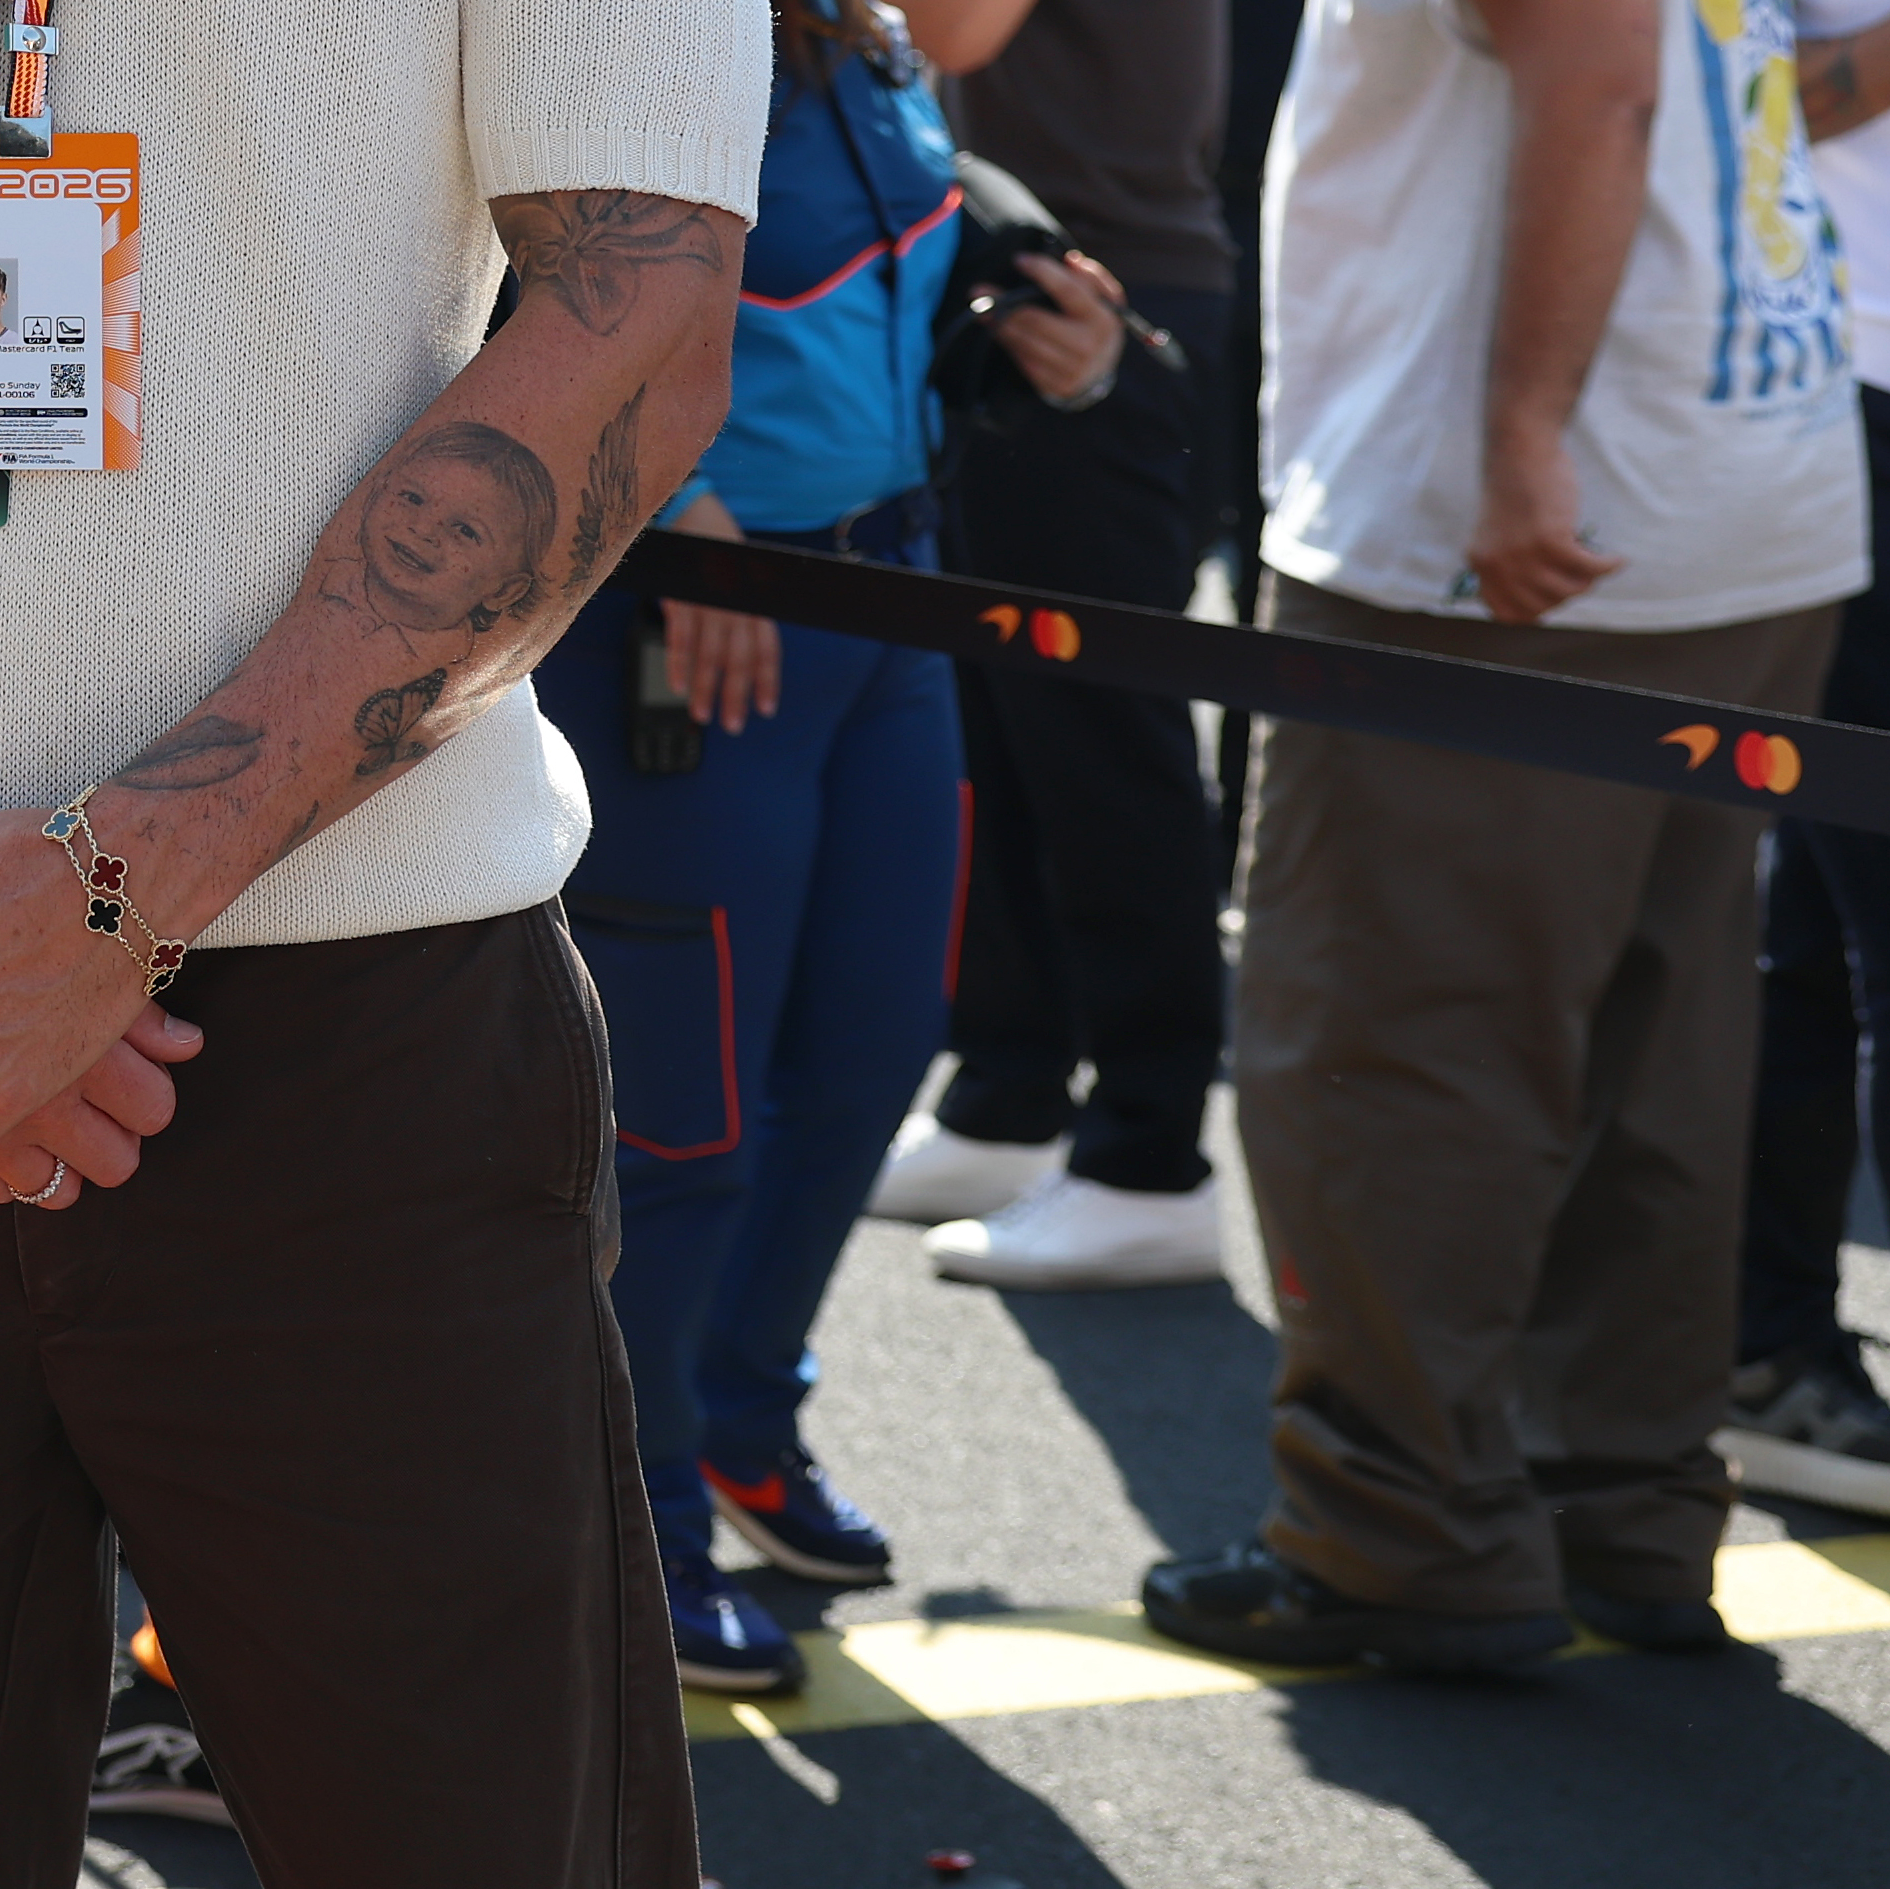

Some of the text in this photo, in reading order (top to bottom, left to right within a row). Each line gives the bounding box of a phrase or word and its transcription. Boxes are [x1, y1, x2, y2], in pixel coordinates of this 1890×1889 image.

[46, 345, 58, 353] F1
[60, 345, 85, 353] Team
[7, 381, 41, 390] Sunday
